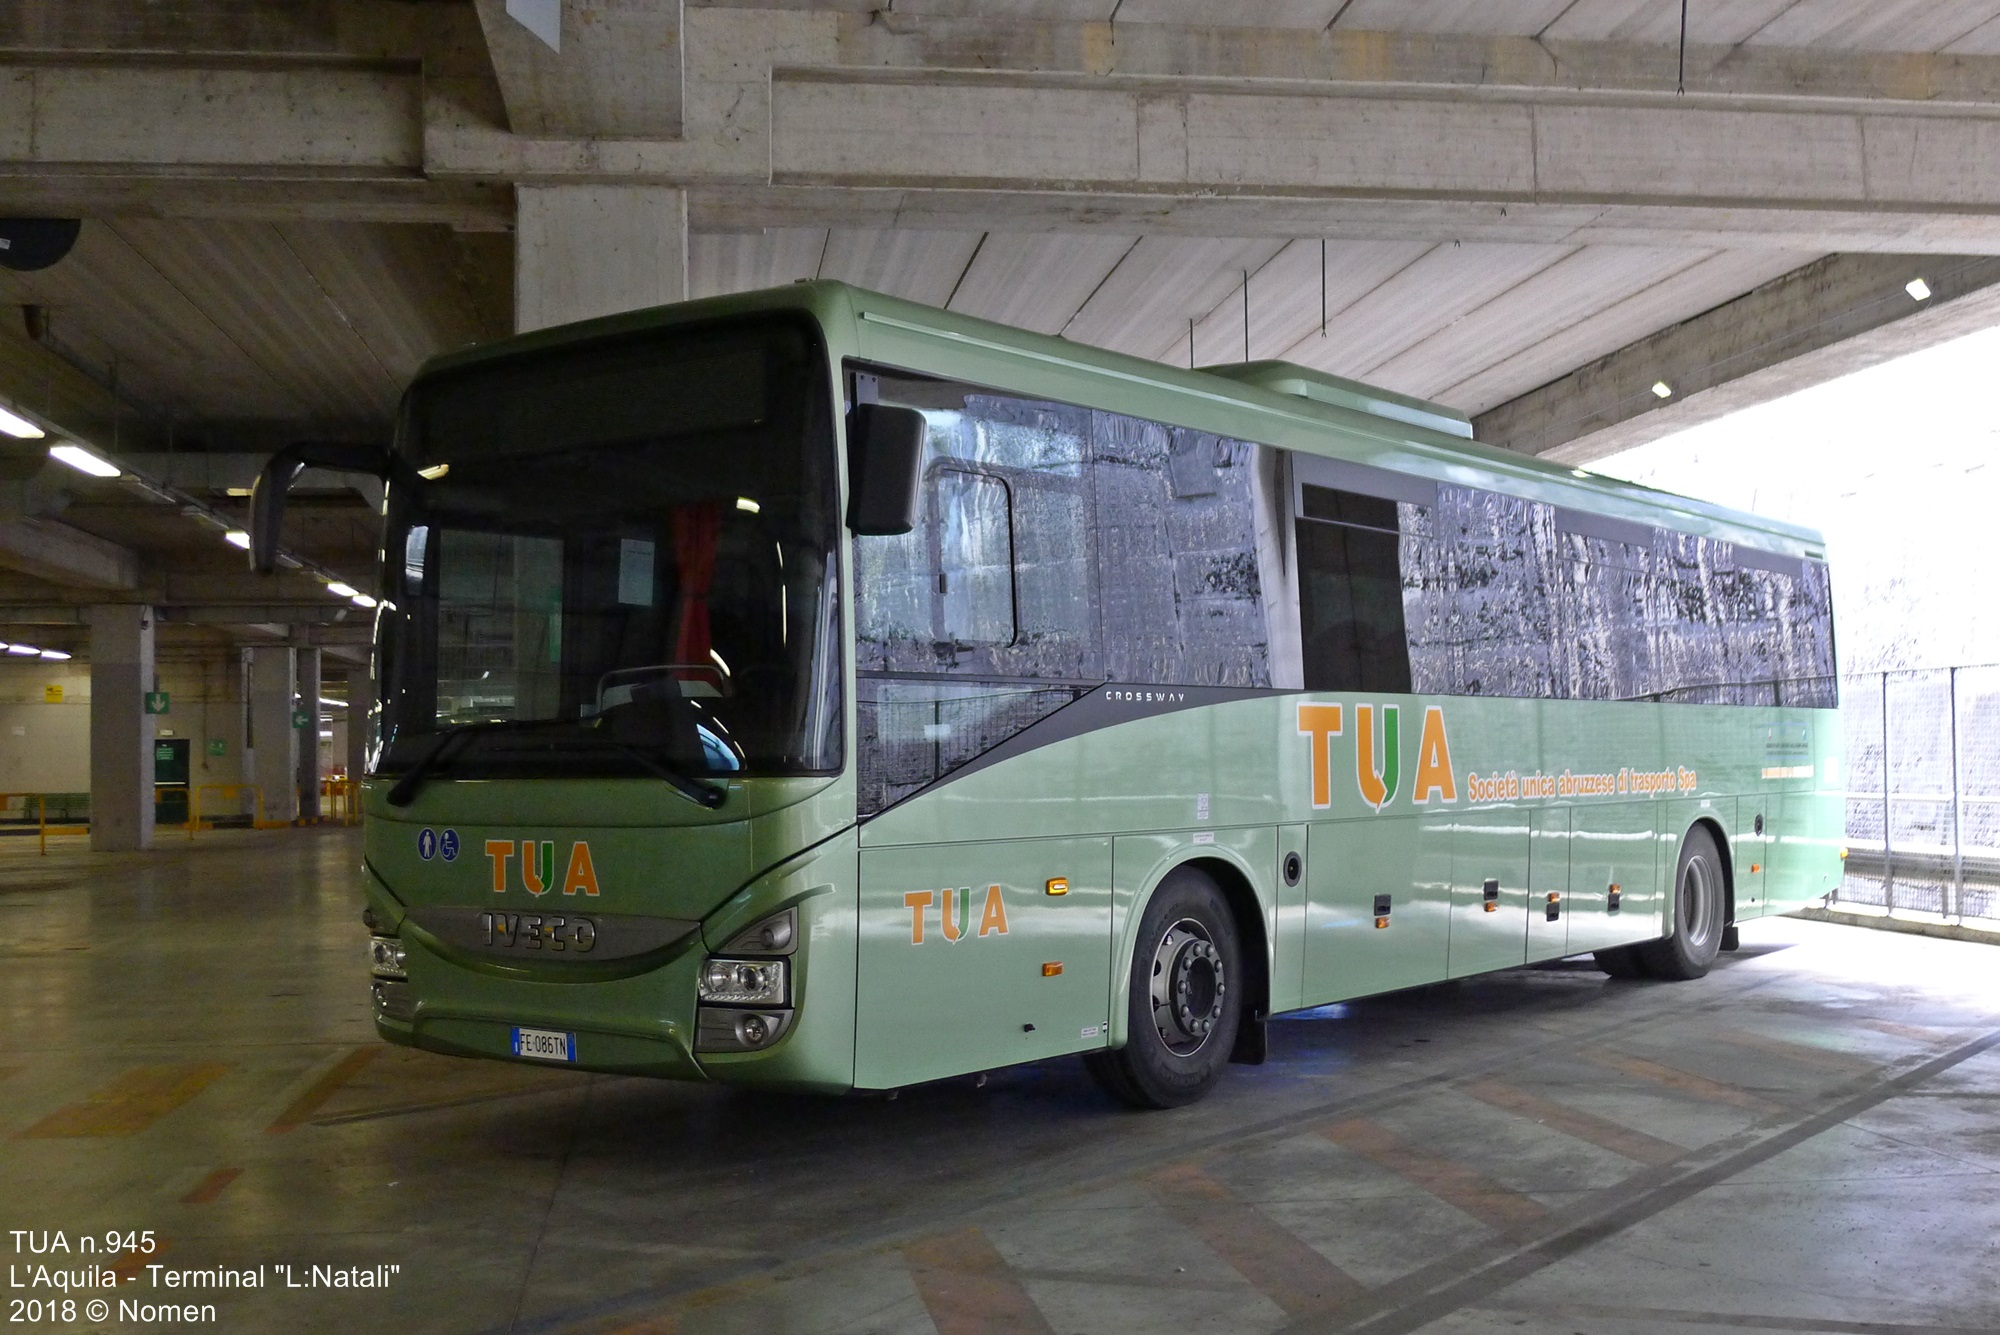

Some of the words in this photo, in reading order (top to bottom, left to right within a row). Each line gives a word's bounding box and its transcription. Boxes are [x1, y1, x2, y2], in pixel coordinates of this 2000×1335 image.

[1105, 691, 1184, 702] CROSSWAY
[1297, 702, 1458, 815] TUA
[1468, 771, 1519, 802] Società
[1521, 769, 1556, 798] unica
[1558, 769, 1615, 798] abruzzese
[1617, 767, 1629, 795] di
[1630, 767, 1676, 798] trasporto
[1677, 765, 1697, 797] Spa
[485, 840, 600, 898] TUA
[482, 912, 597, 953] IVECO
[904, 883, 1009, 945] TUA
